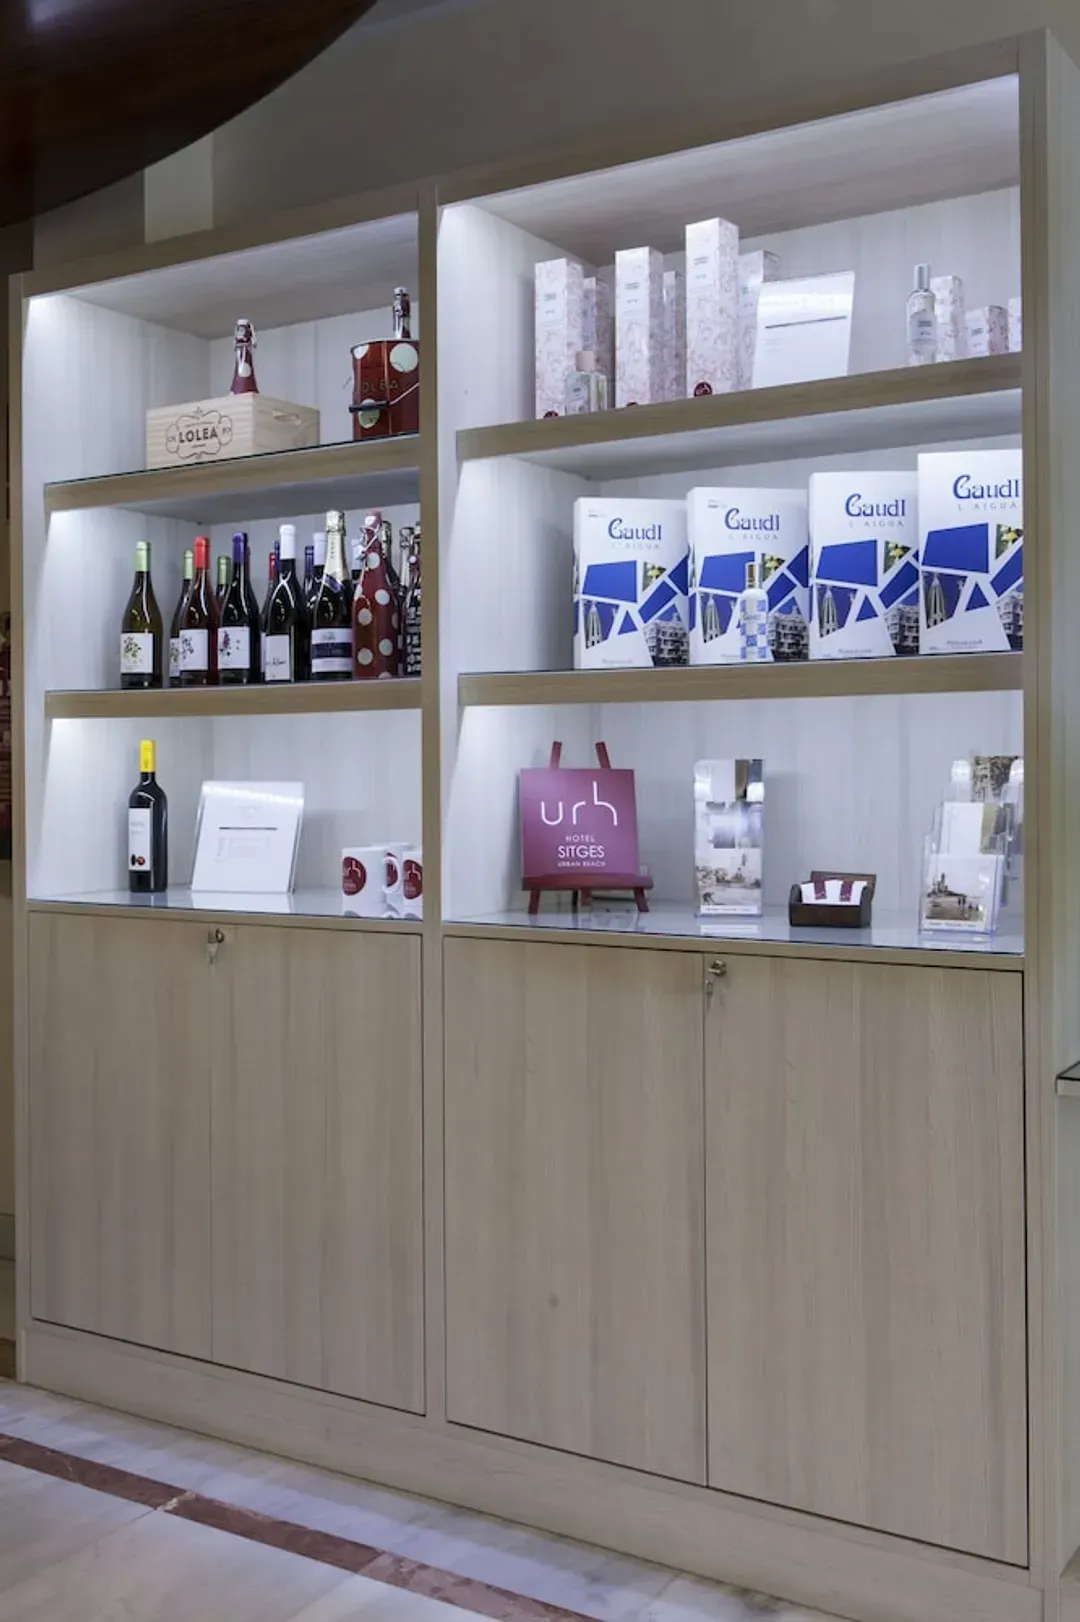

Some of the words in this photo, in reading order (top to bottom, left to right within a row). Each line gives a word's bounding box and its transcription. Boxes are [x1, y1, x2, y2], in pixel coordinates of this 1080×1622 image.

[178, 426, 218, 443] LOLEA
[540, 780, 618, 826] urh
[565, 834, 596, 843] HOTEL
[557, 844, 605, 859] SITGES
[557, 860, 581, 868] URBAN
[582, 860, 606, 868] BEACH
